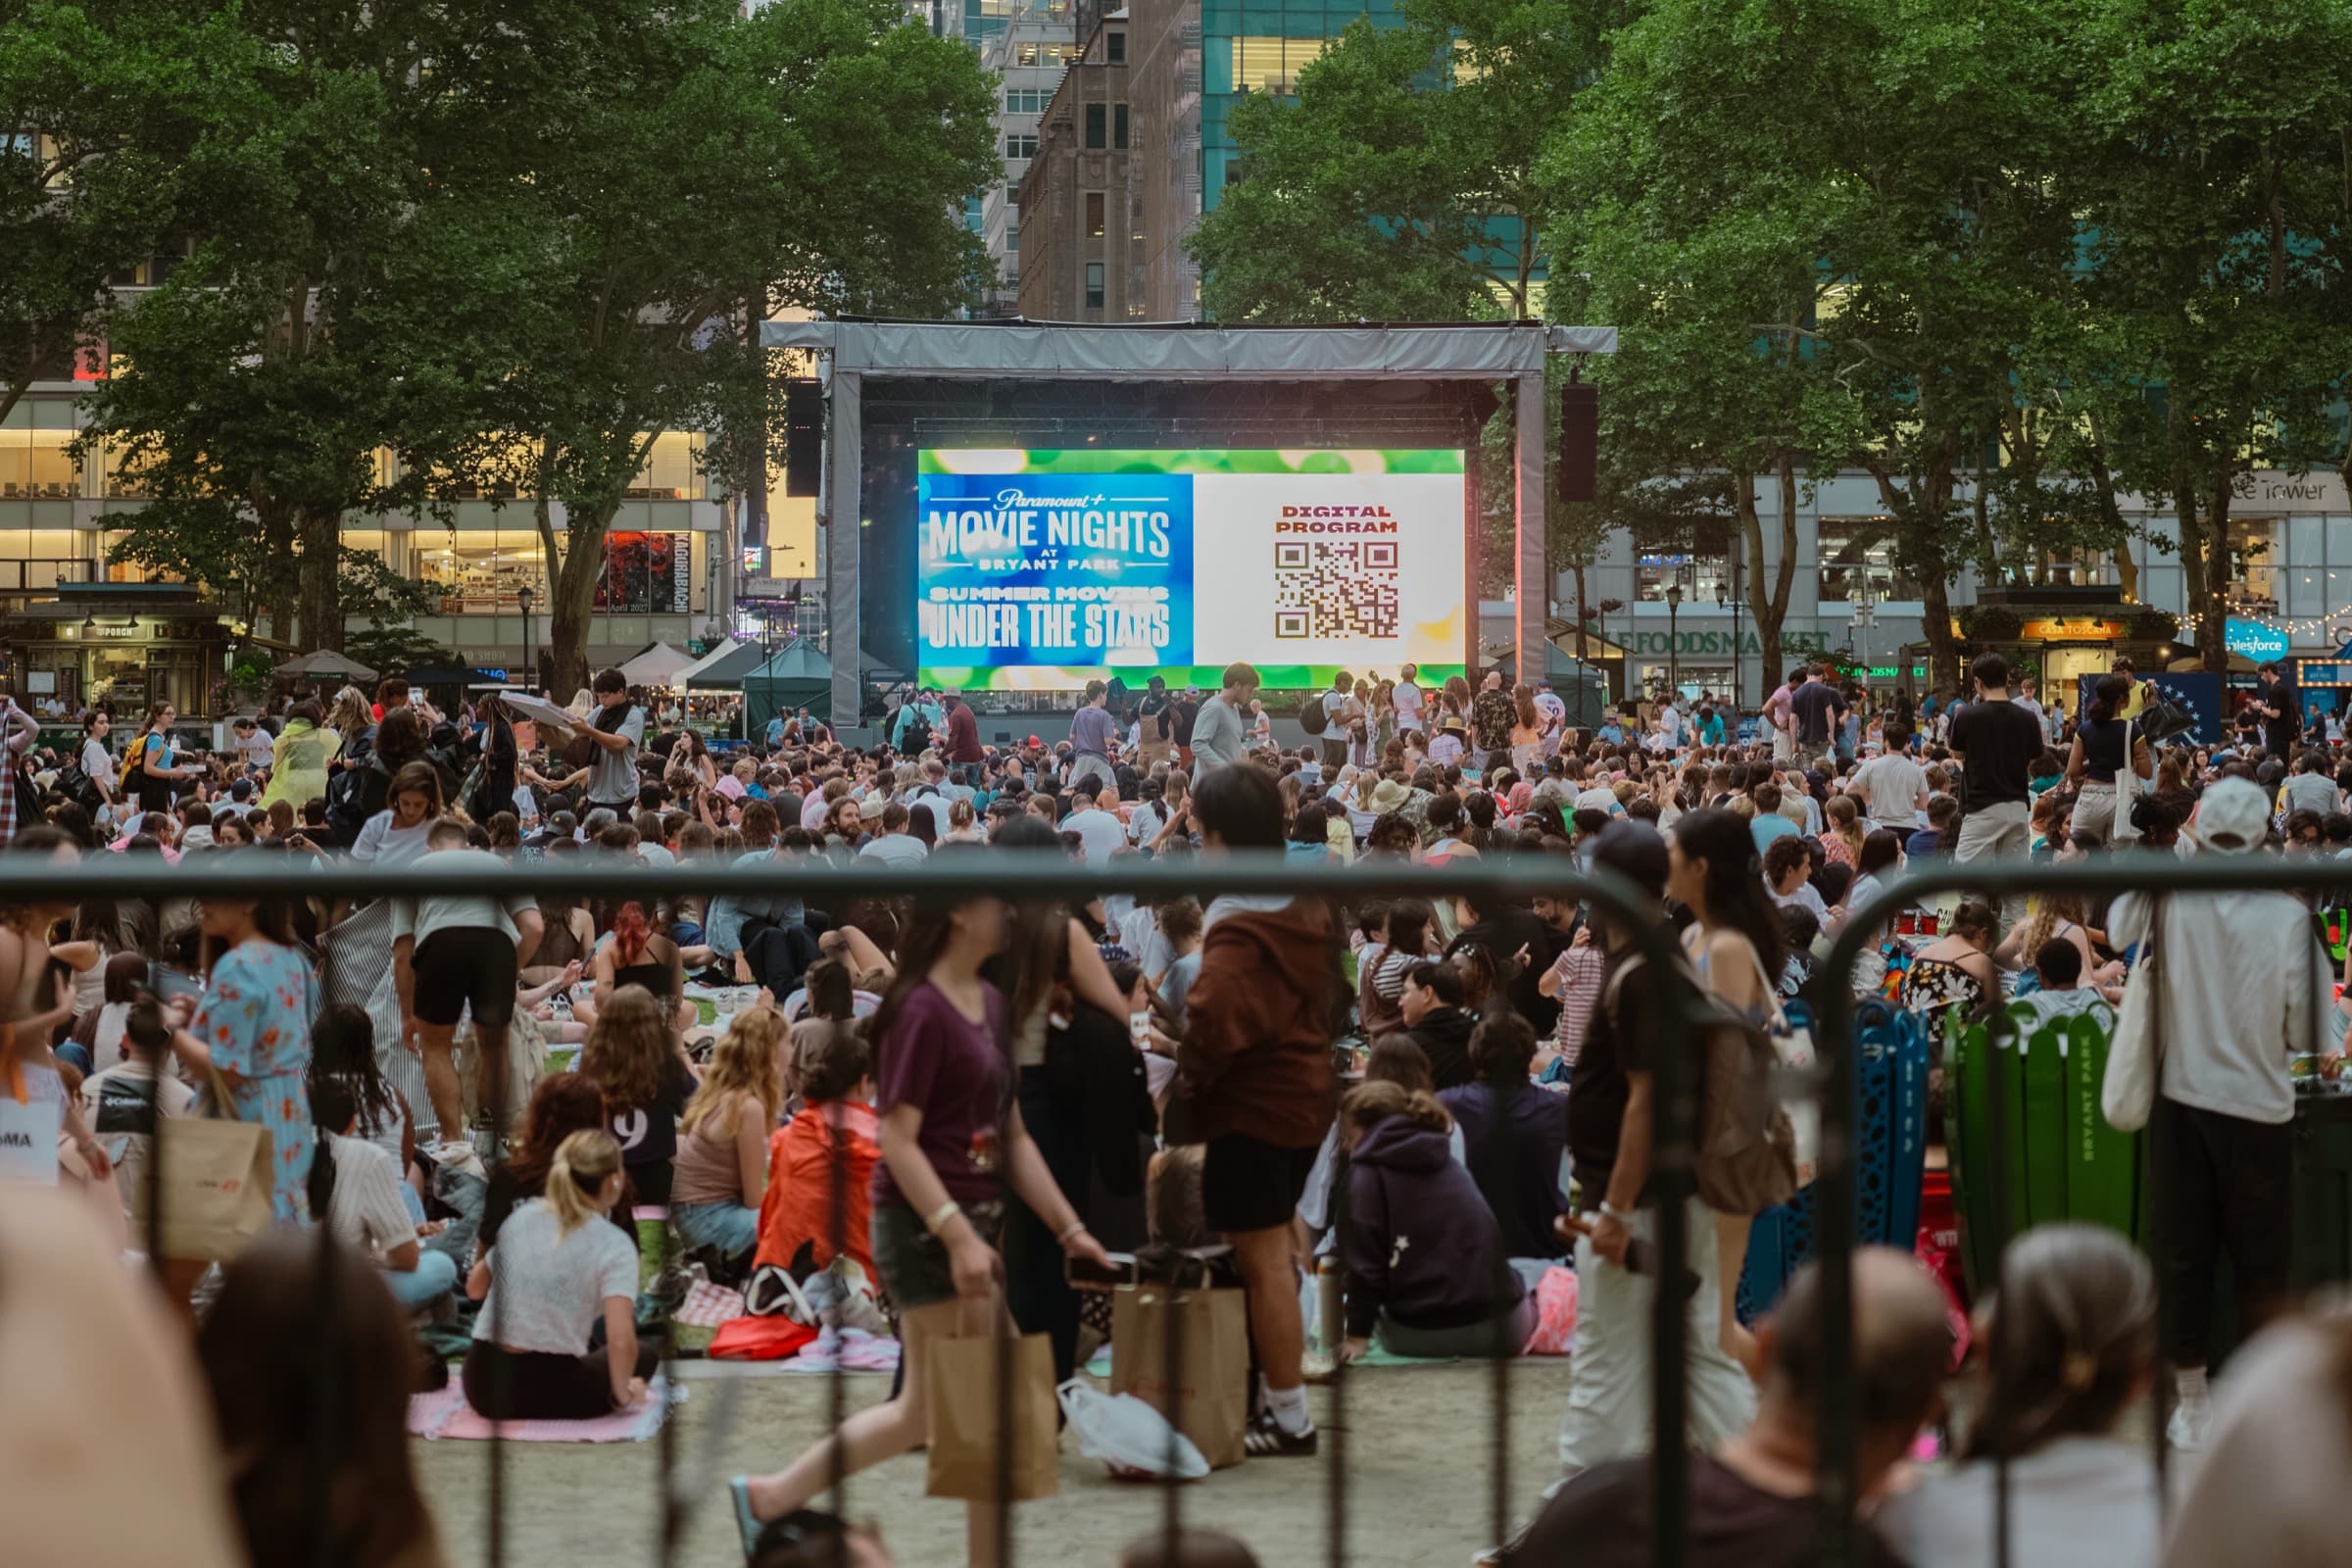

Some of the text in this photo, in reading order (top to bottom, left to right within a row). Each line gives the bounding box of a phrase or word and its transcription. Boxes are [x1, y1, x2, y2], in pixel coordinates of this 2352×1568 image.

[2261, 479, 2327, 500] Tower
[993, 488, 1105, 511] Paramount+
[1282, 506, 1392, 518] DIGITAL
[930, 511, 1170, 560] MOVIE NIGHTS
[1276, 521, 1398, 534] PROGRAM
[1041, 549, 1058, 558] AT
[980, 560, 1120, 570] BRYANT PARK
[929, 587, 1170, 602] SUMMER MOVIES
[105, 627, 132, 636] PORCH
[929, 603, 1170, 649] UNDER THE STARS
[2038, 625, 2112, 635] CASA TOSCANA
[1637, 631, 1719, 655] FOODS
[1721, 631, 1831, 655] MAKET
[2225, 636, 2282, 654] salesforce
[2080, 1035, 2094, 1160] BRYANT PARK
